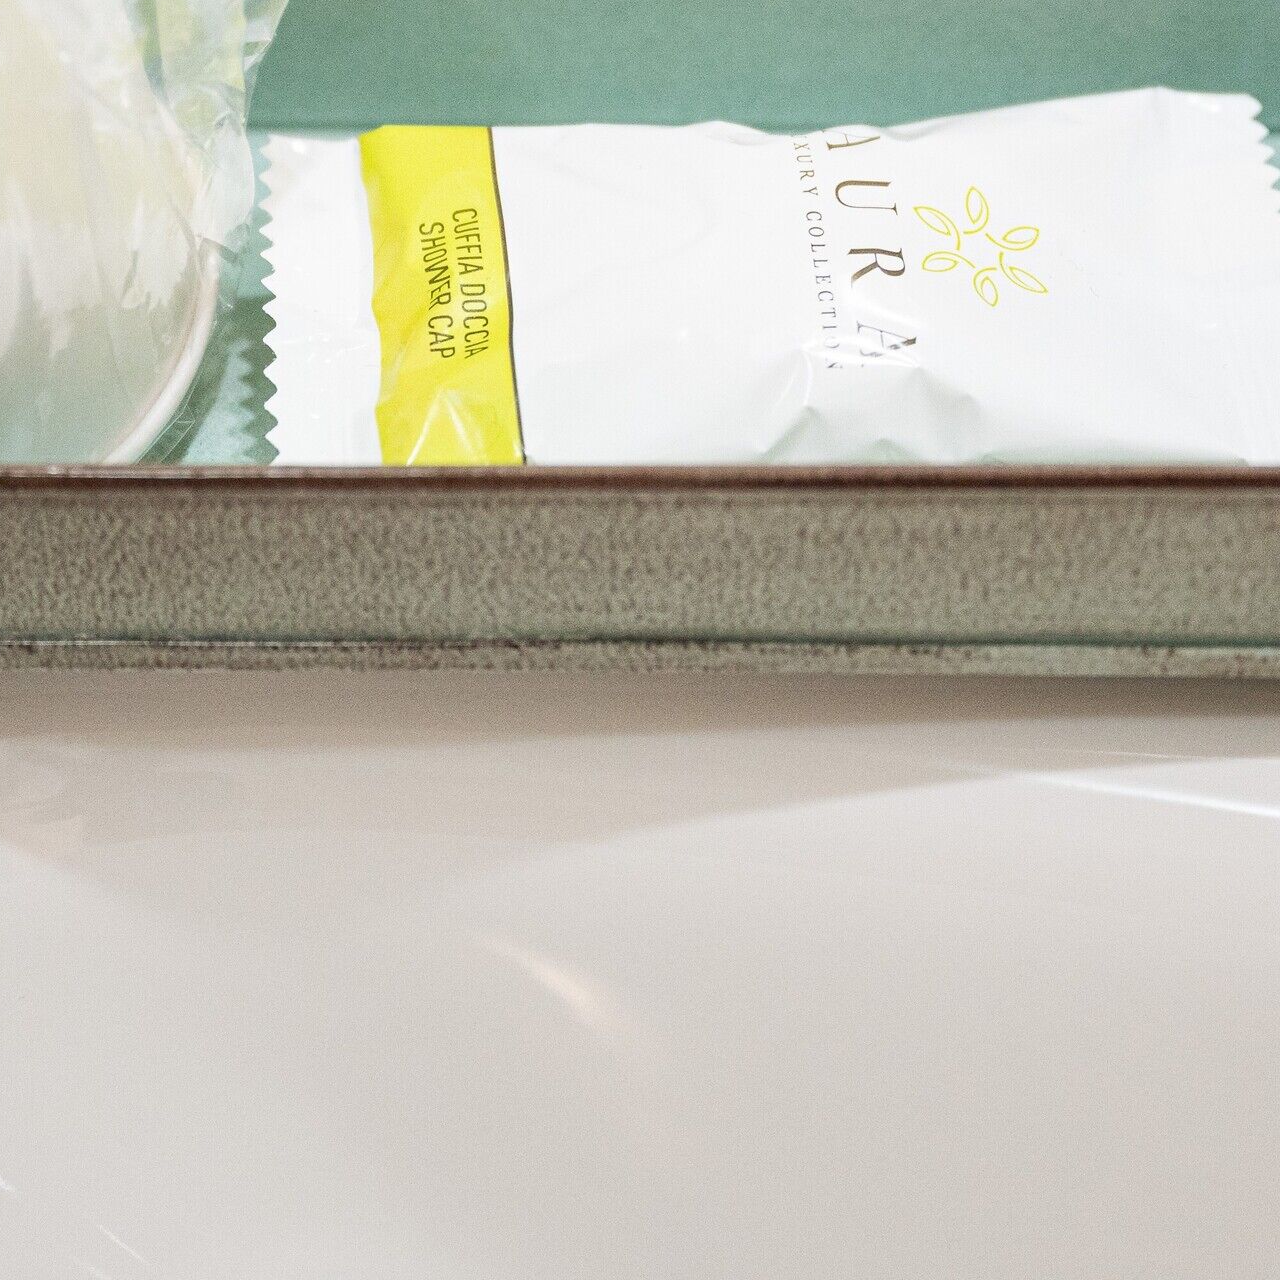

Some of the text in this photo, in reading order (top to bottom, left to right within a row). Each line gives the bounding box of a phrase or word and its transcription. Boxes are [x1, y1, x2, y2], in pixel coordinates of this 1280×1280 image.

[419, 221, 456, 359] SHOWER CAP
[452, 207, 490, 359] CUFFIA DOCCIA
[821, 129, 917, 360] AURA
